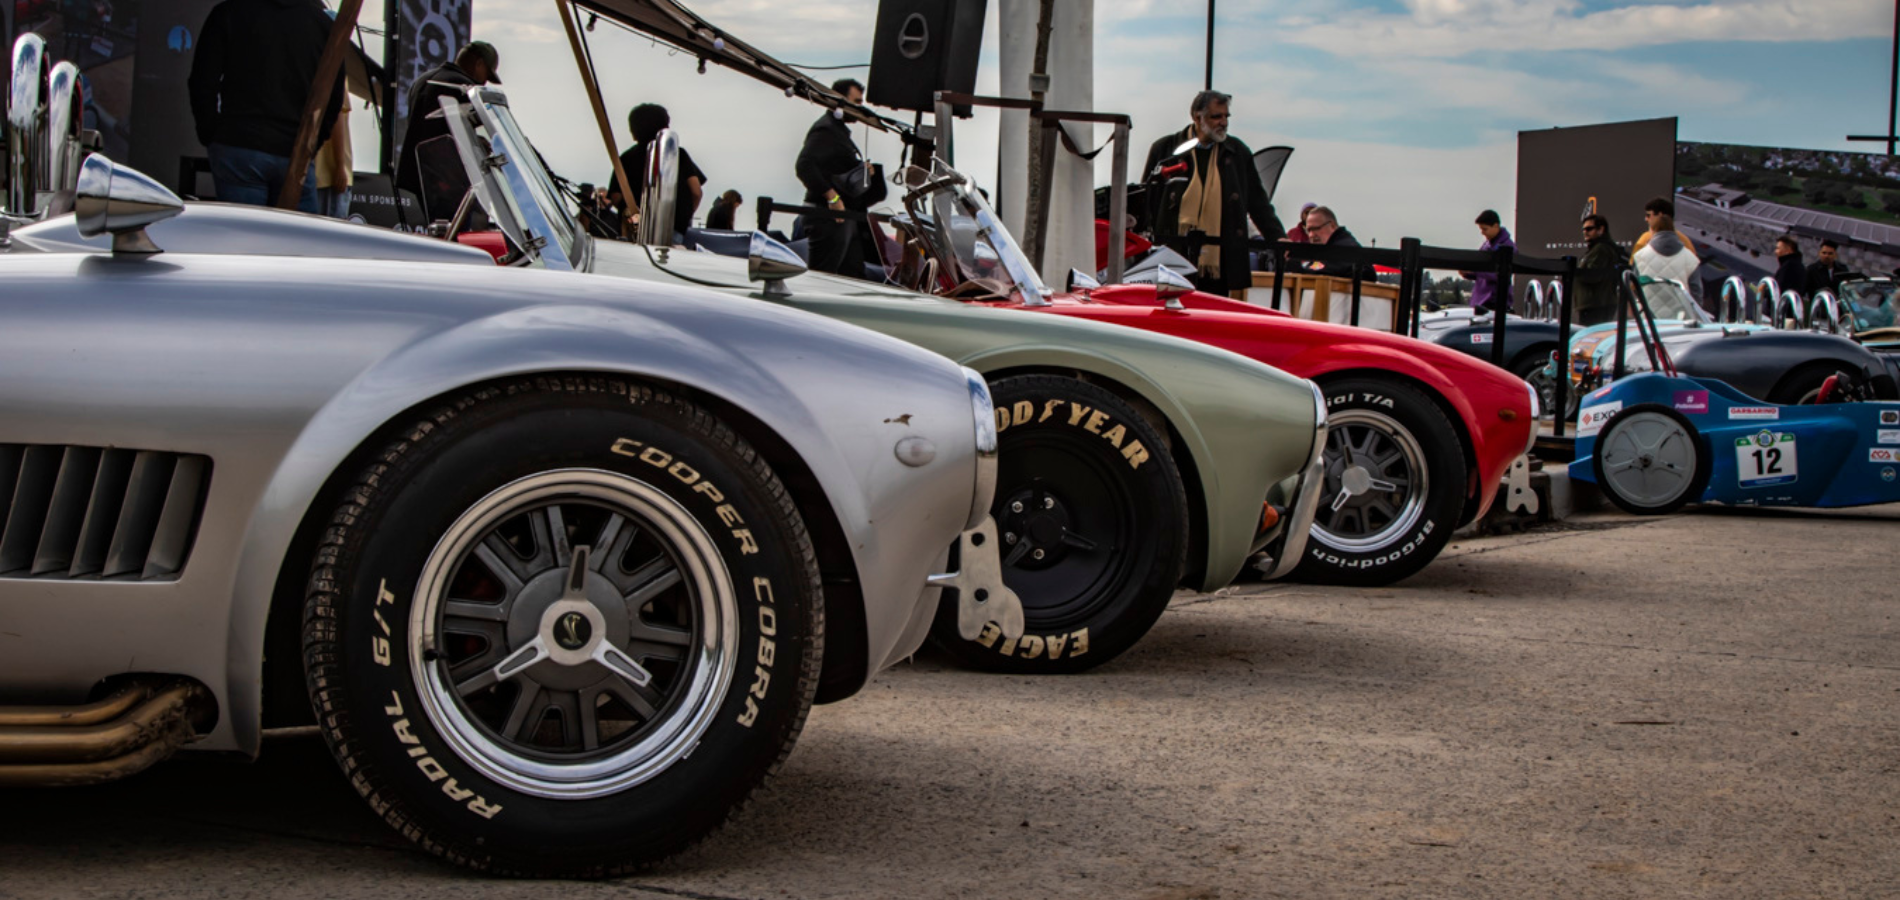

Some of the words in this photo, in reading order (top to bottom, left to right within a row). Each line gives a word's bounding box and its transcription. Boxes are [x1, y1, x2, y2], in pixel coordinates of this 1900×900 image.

[353, 194, 367, 203] AIN
[369, 195, 411, 206] SPONSRS
[995, 400, 1034, 433] OD
[1326, 394, 1354, 407] ial
[1362, 392, 1395, 409] T/A
[1752, 448, 1782, 475] 12
[1312, 519, 1435, 569] BFGoodrich
[610, 436, 759, 556] COOPER
[736, 575, 778, 729] COBRA
[371, 577, 398, 668] G/T
[383, 689, 504, 821] RADIAL
